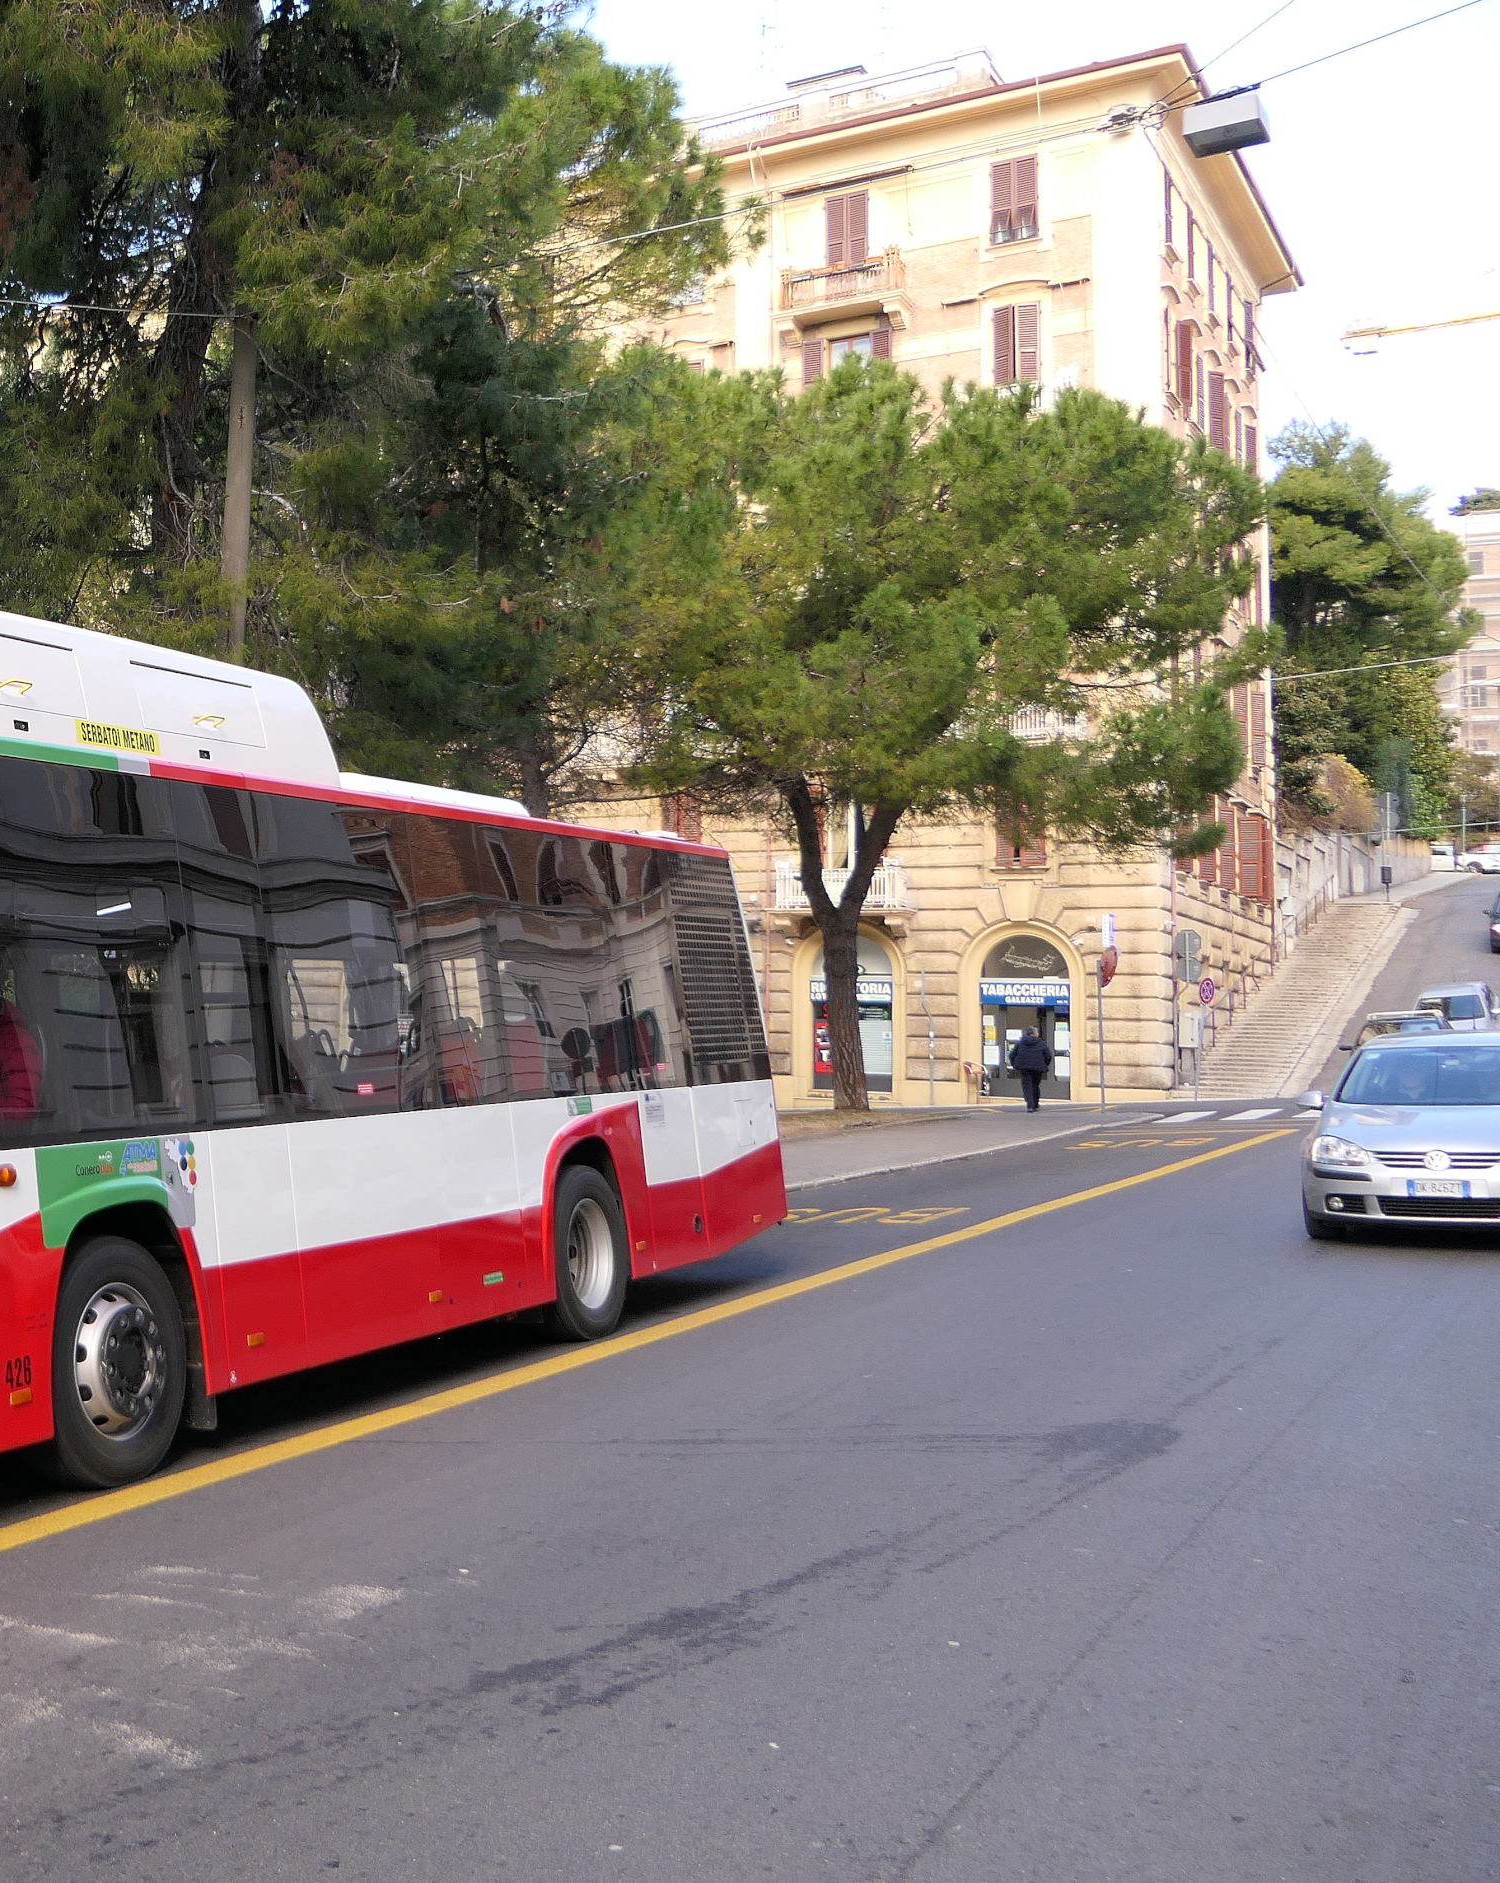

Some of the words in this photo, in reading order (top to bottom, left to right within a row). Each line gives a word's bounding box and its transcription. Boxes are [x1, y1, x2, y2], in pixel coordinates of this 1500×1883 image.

[81, 722, 121, 746] SERBATOI
[122, 730, 155, 752] METANO
[981, 984, 1069, 997] TABACCHERIA
[1064, 1137, 1218, 1151] BUS
[5, 1354, 32, 1389] 426
